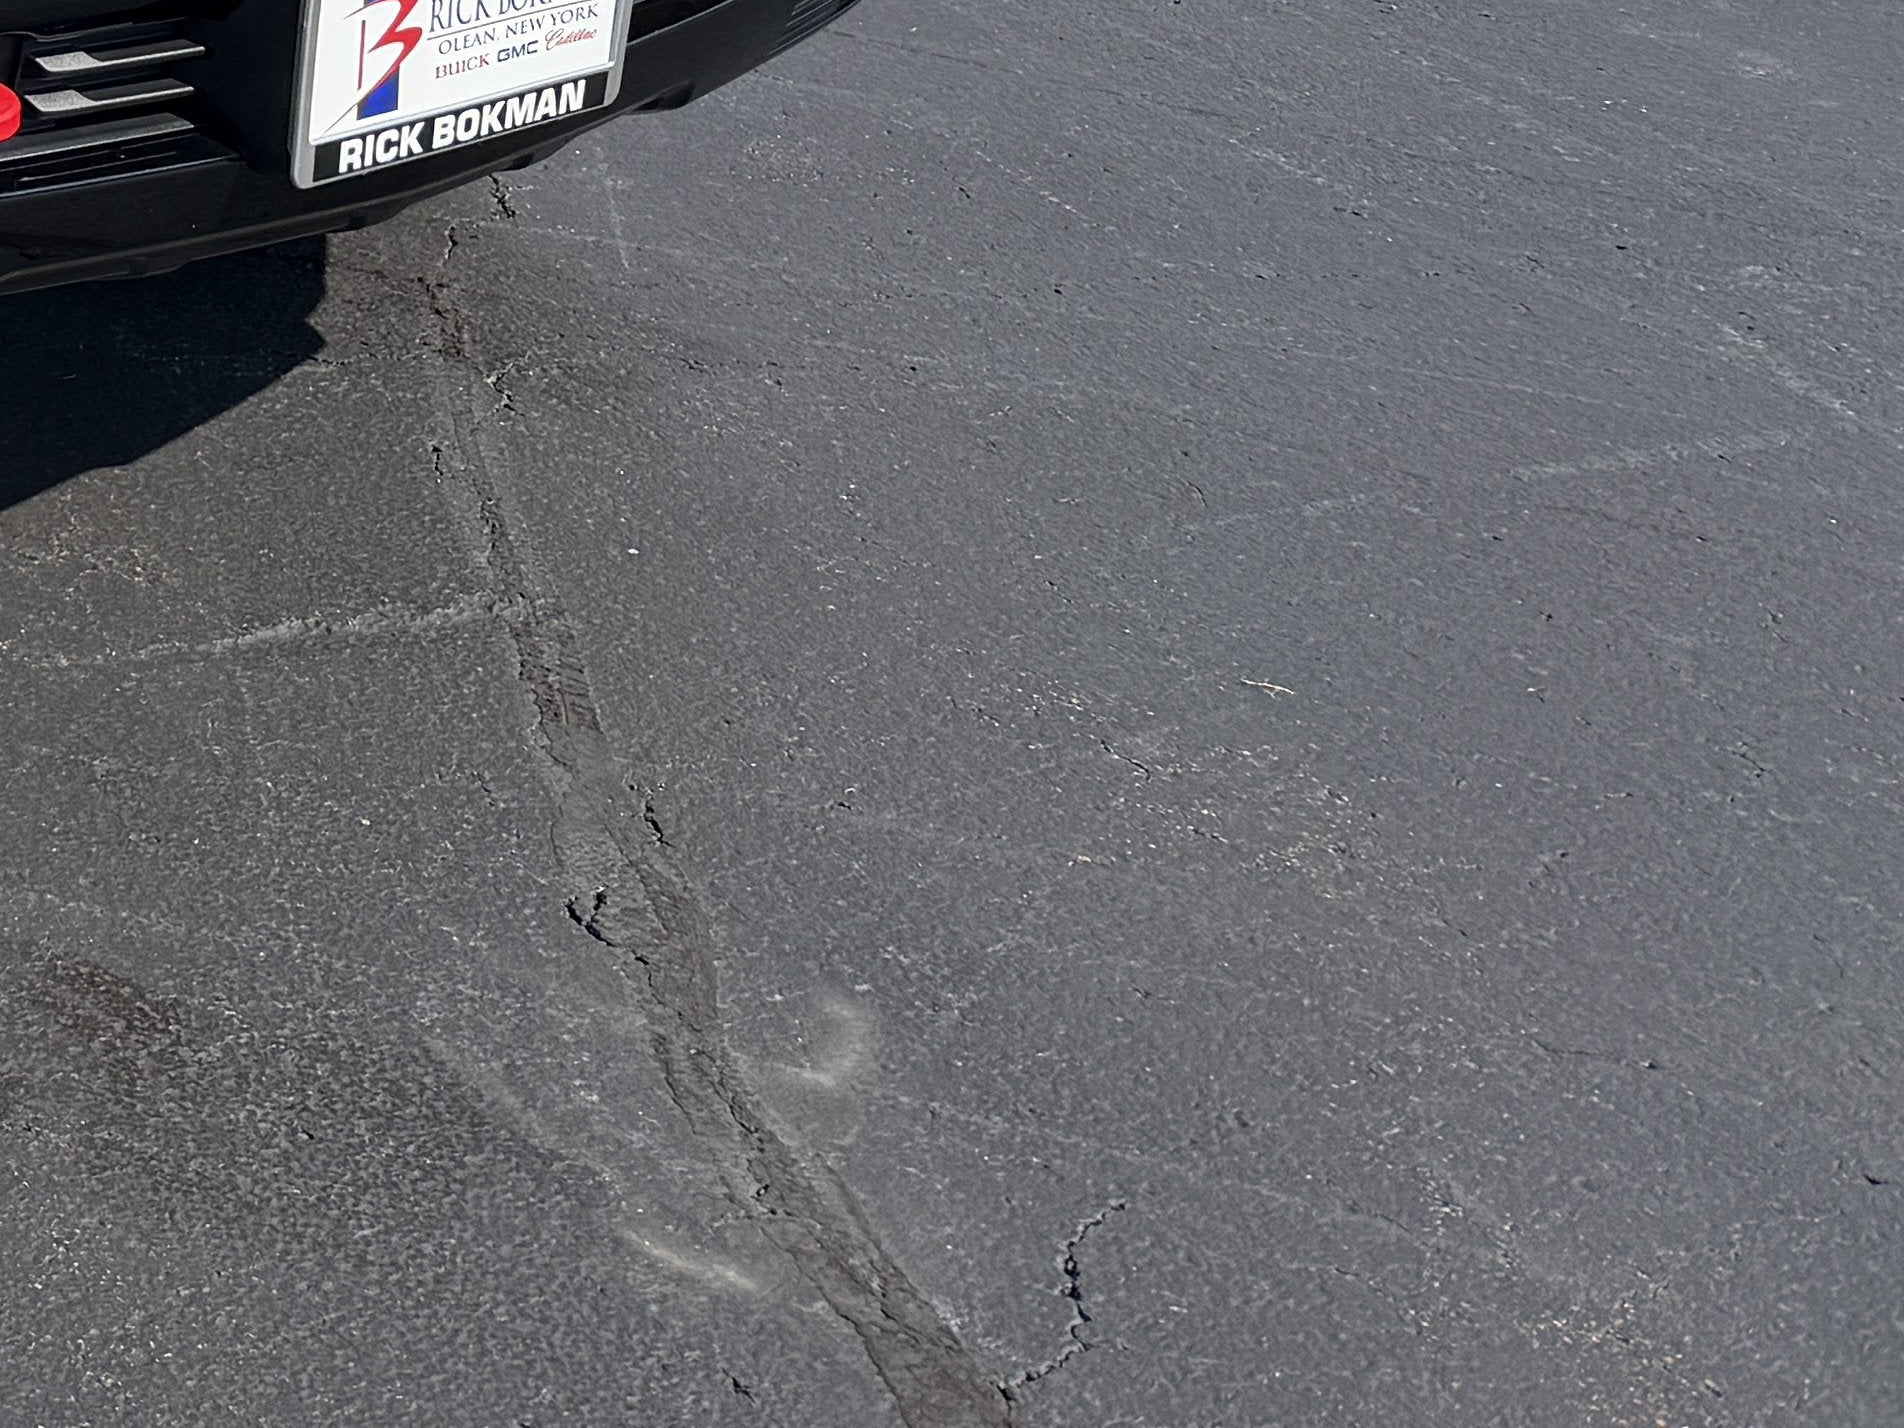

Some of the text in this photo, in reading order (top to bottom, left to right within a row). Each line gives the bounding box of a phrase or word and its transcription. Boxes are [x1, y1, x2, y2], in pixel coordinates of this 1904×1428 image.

[506, 15, 545, 39] NEW
[551, 3, 598, 25] YORK
[435, 28, 597, 79] BUICK GMC Cadillac
[338, 79, 586, 174] RICK BOKMAN
